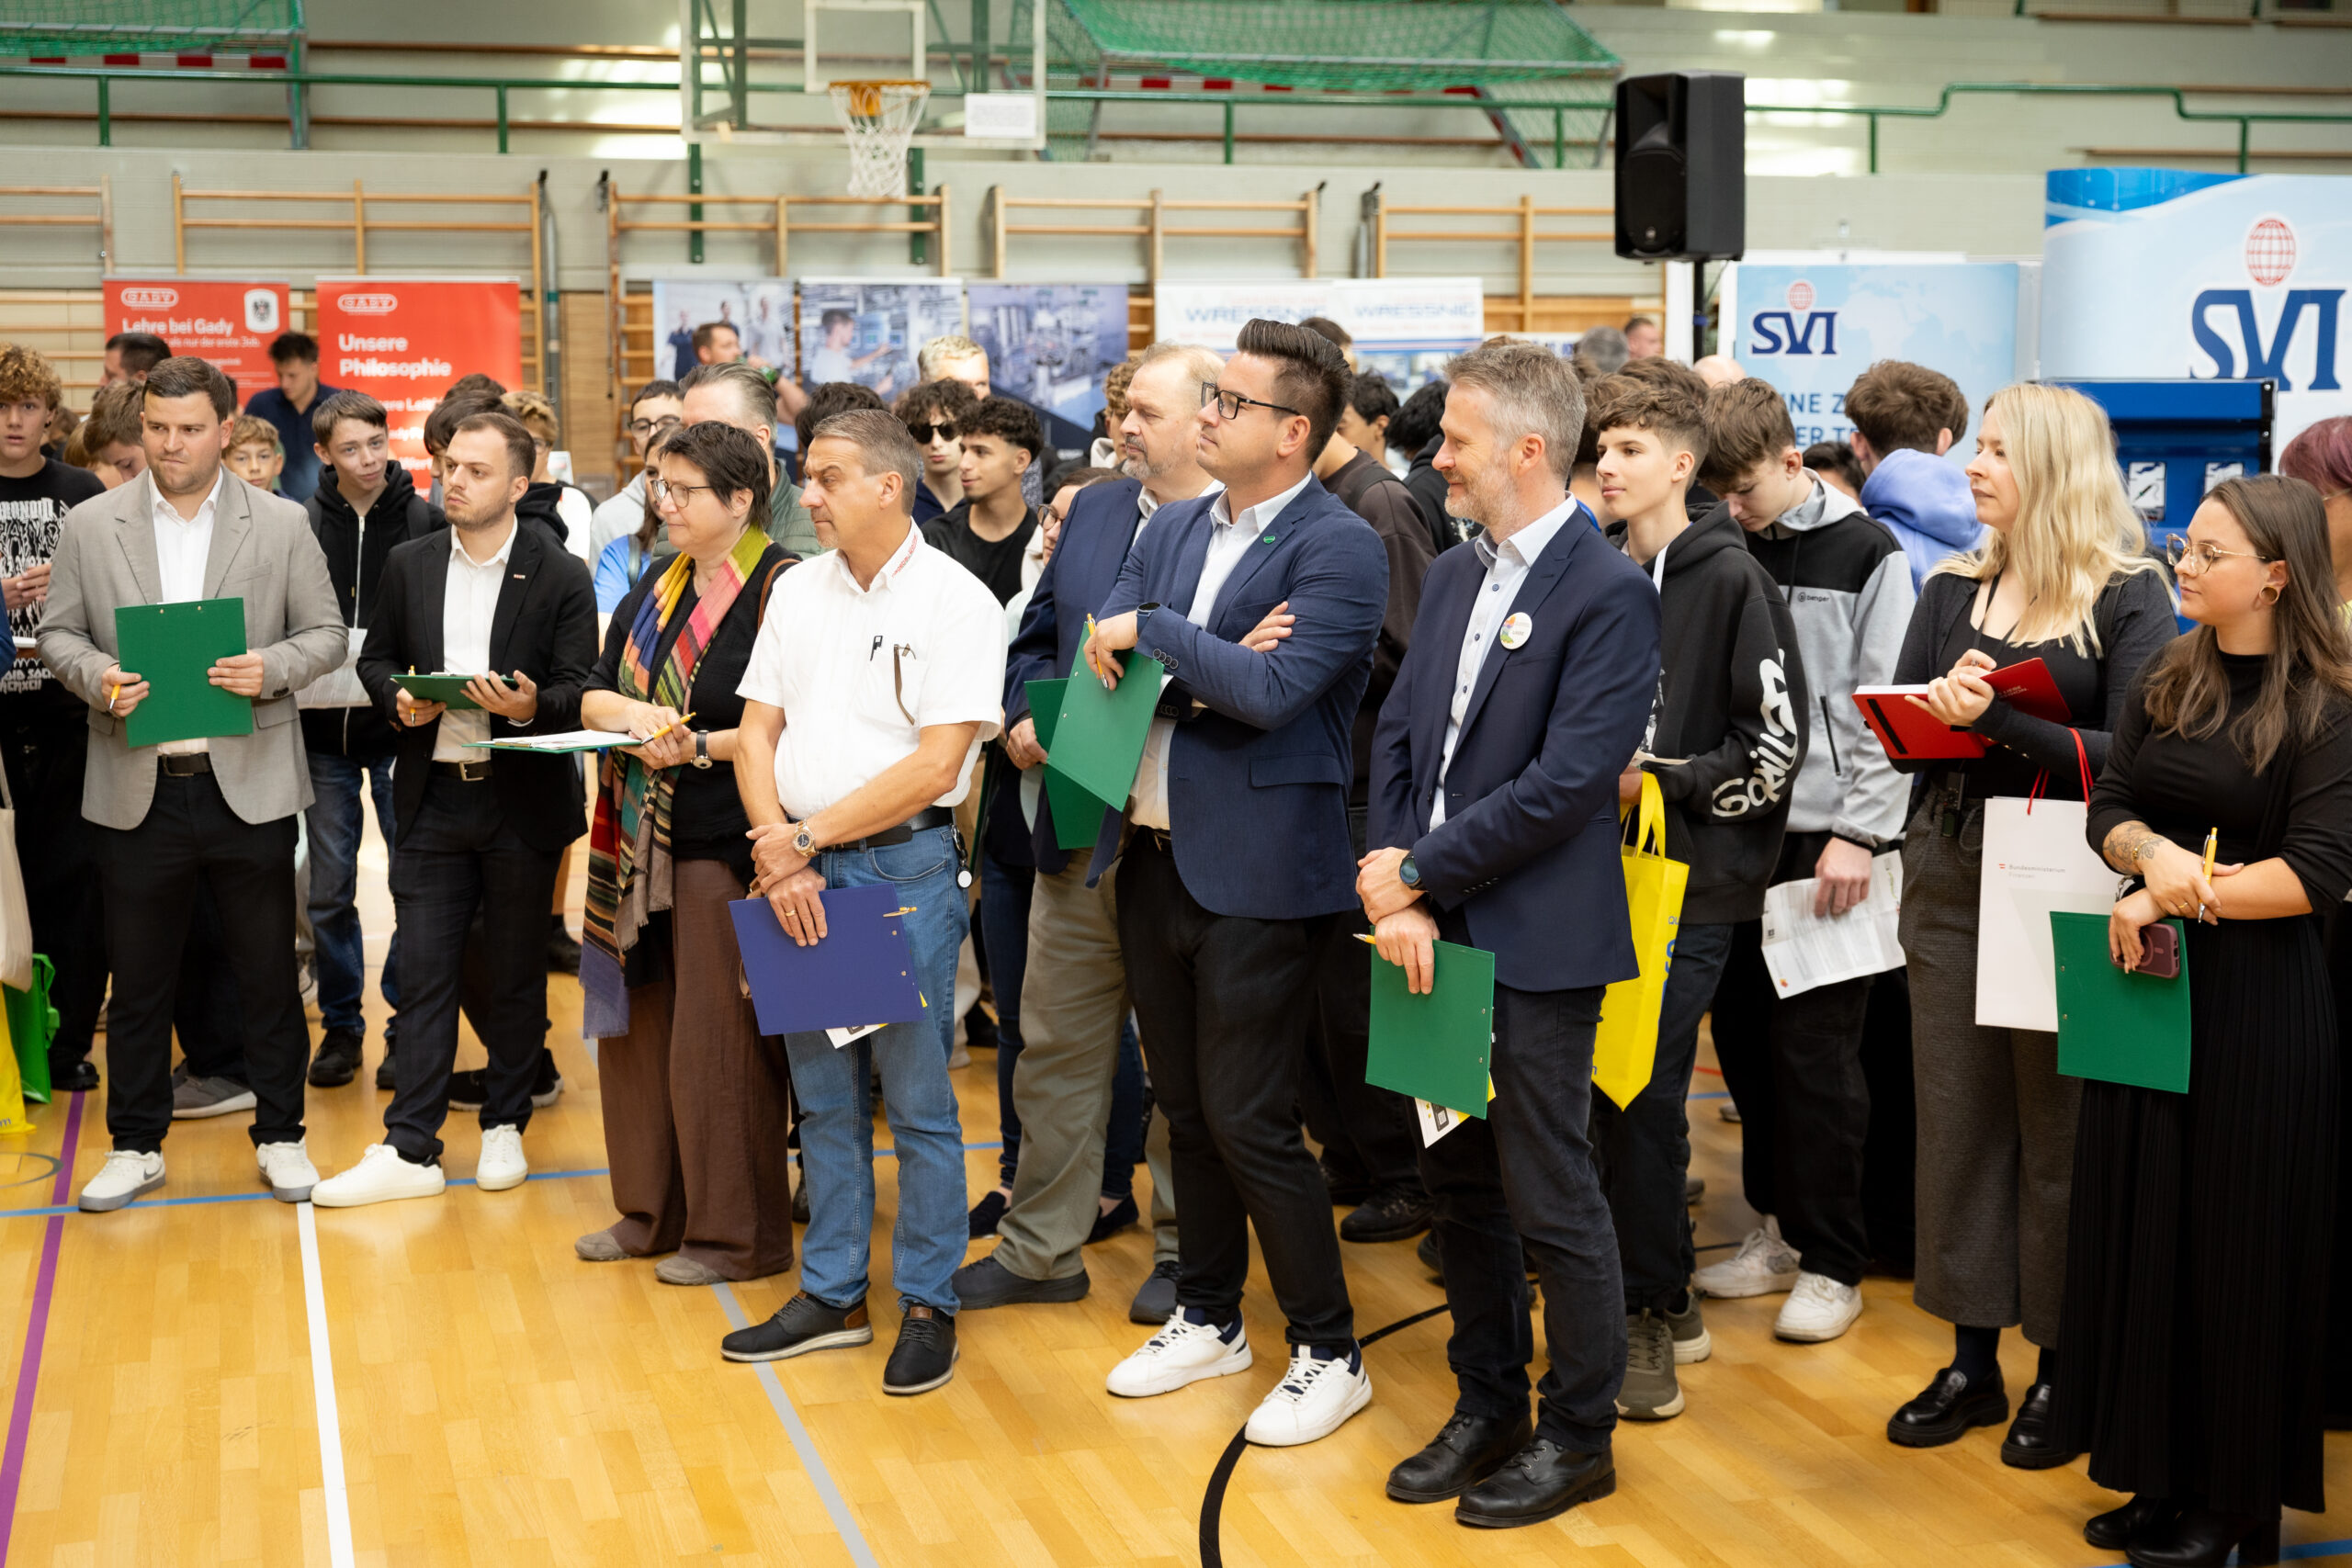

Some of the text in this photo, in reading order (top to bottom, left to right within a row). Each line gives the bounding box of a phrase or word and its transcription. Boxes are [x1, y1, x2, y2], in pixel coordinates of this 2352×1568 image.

[122, 317, 234, 338] Lehre bei Gady
[1751, 311, 1838, 355] SVI
[338, 333, 409, 352] Unsere
[2190, 288, 2346, 392] SVI
[339, 357, 453, 381] Philosophie
